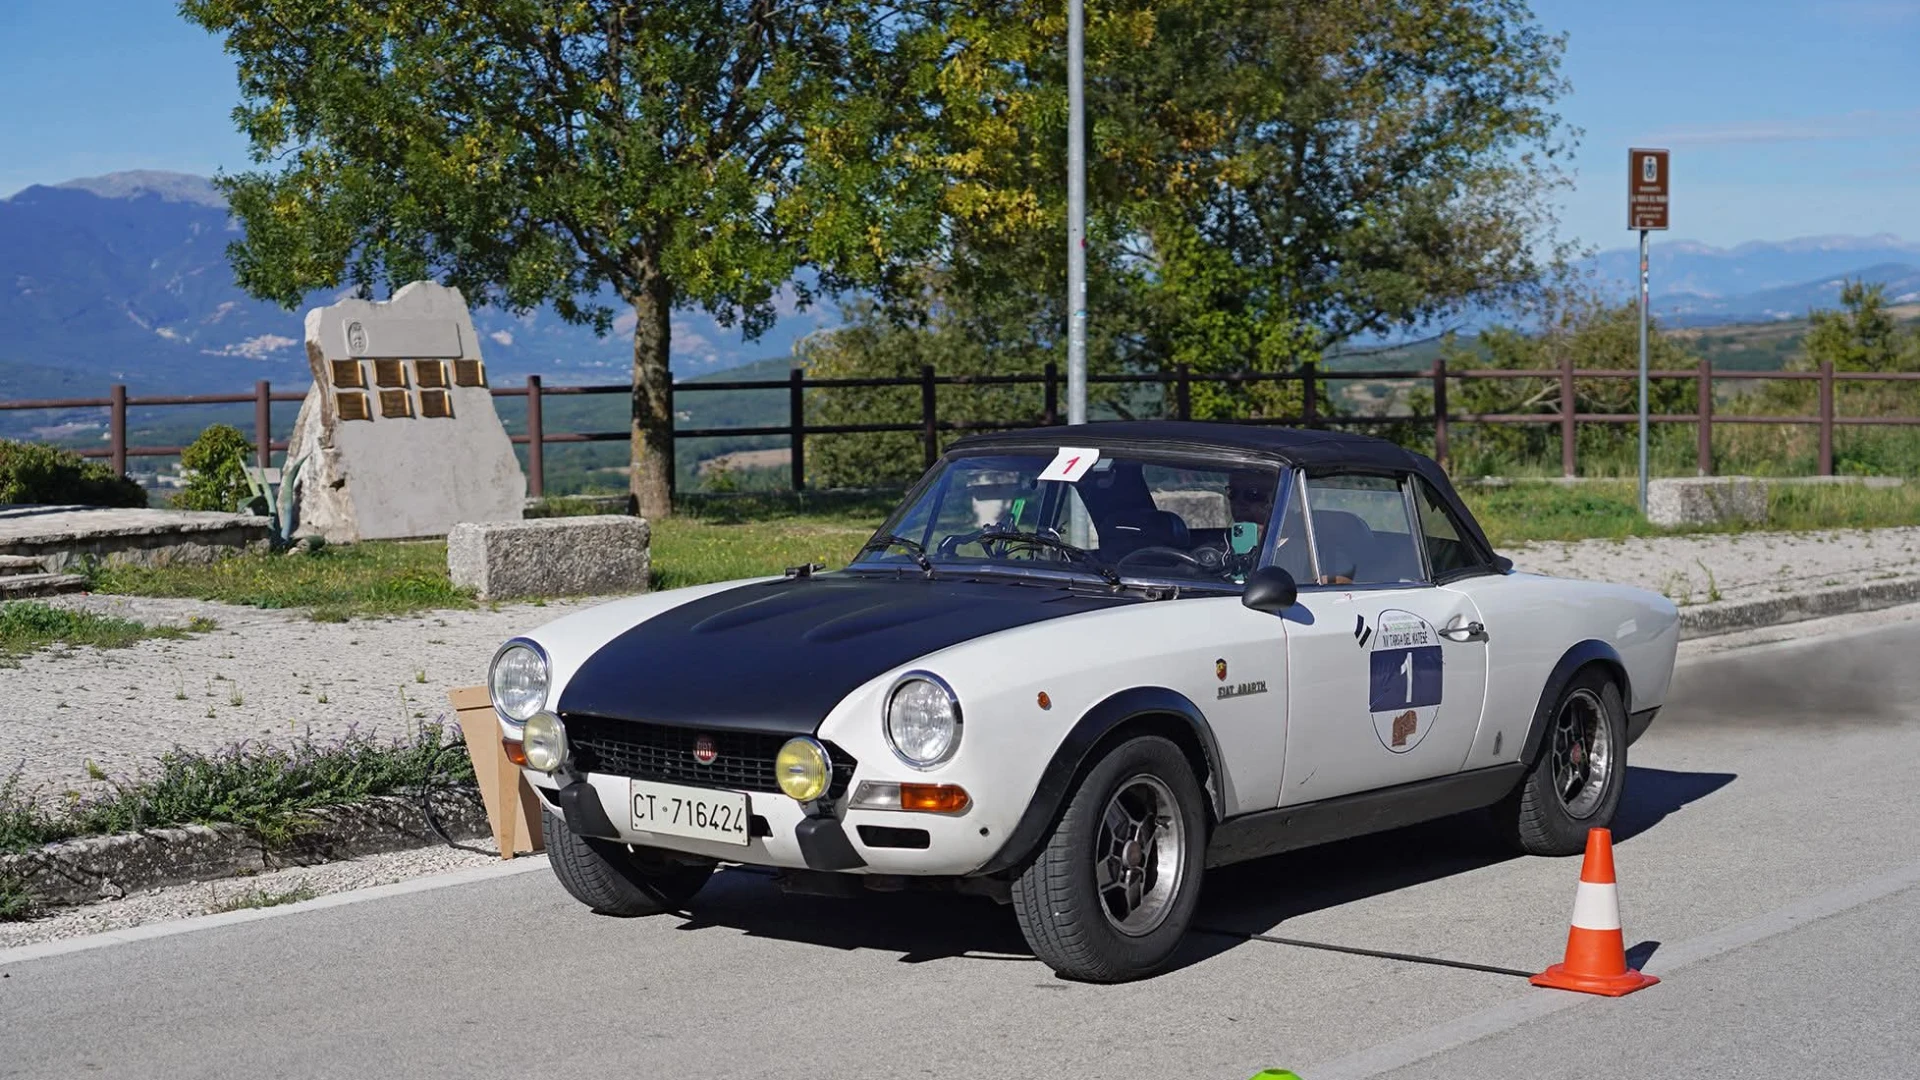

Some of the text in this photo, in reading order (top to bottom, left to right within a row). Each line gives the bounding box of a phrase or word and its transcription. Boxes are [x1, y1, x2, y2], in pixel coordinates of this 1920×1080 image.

[1063, 456, 1081, 475] 1
[1217, 685, 1235, 698] FIAT
[1400, 651, 1413, 703] 1
[633, 793, 744, 834] CT 716424
